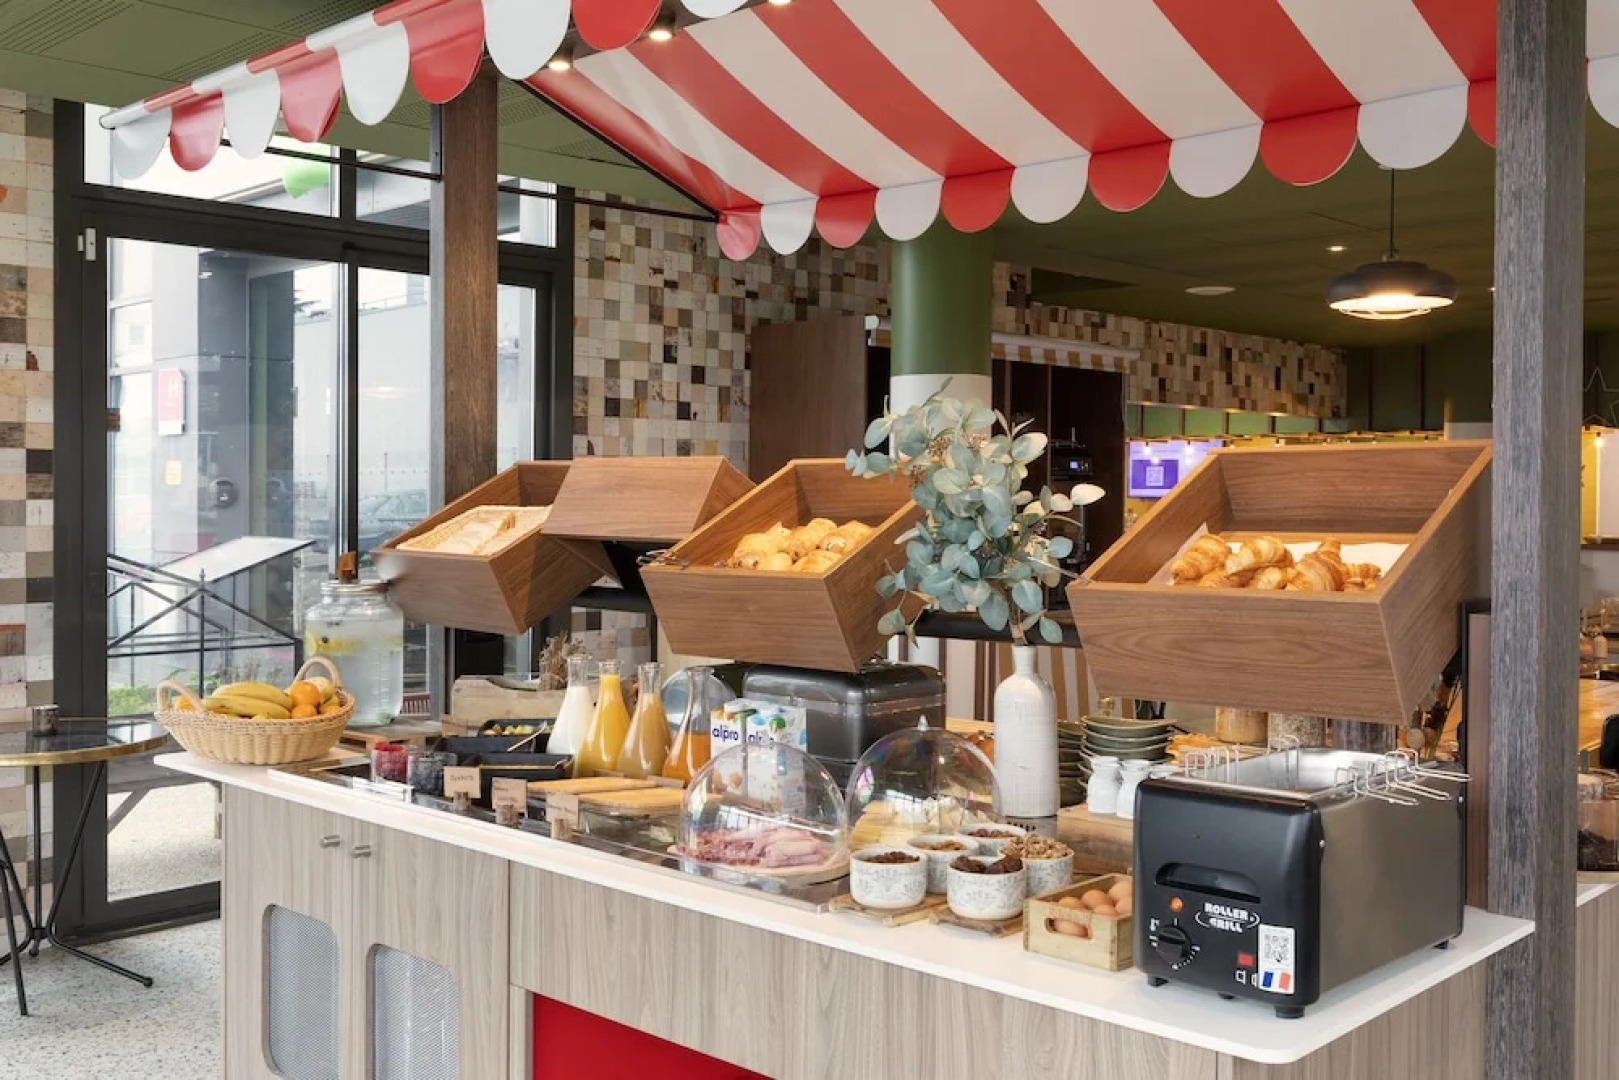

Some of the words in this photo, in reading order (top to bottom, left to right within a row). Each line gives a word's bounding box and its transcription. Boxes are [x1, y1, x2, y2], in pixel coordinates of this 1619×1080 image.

[712, 725, 739, 742] alpro
[1204, 902, 1248, 920] ROLLER
[1209, 917, 1243, 933] GRILL
